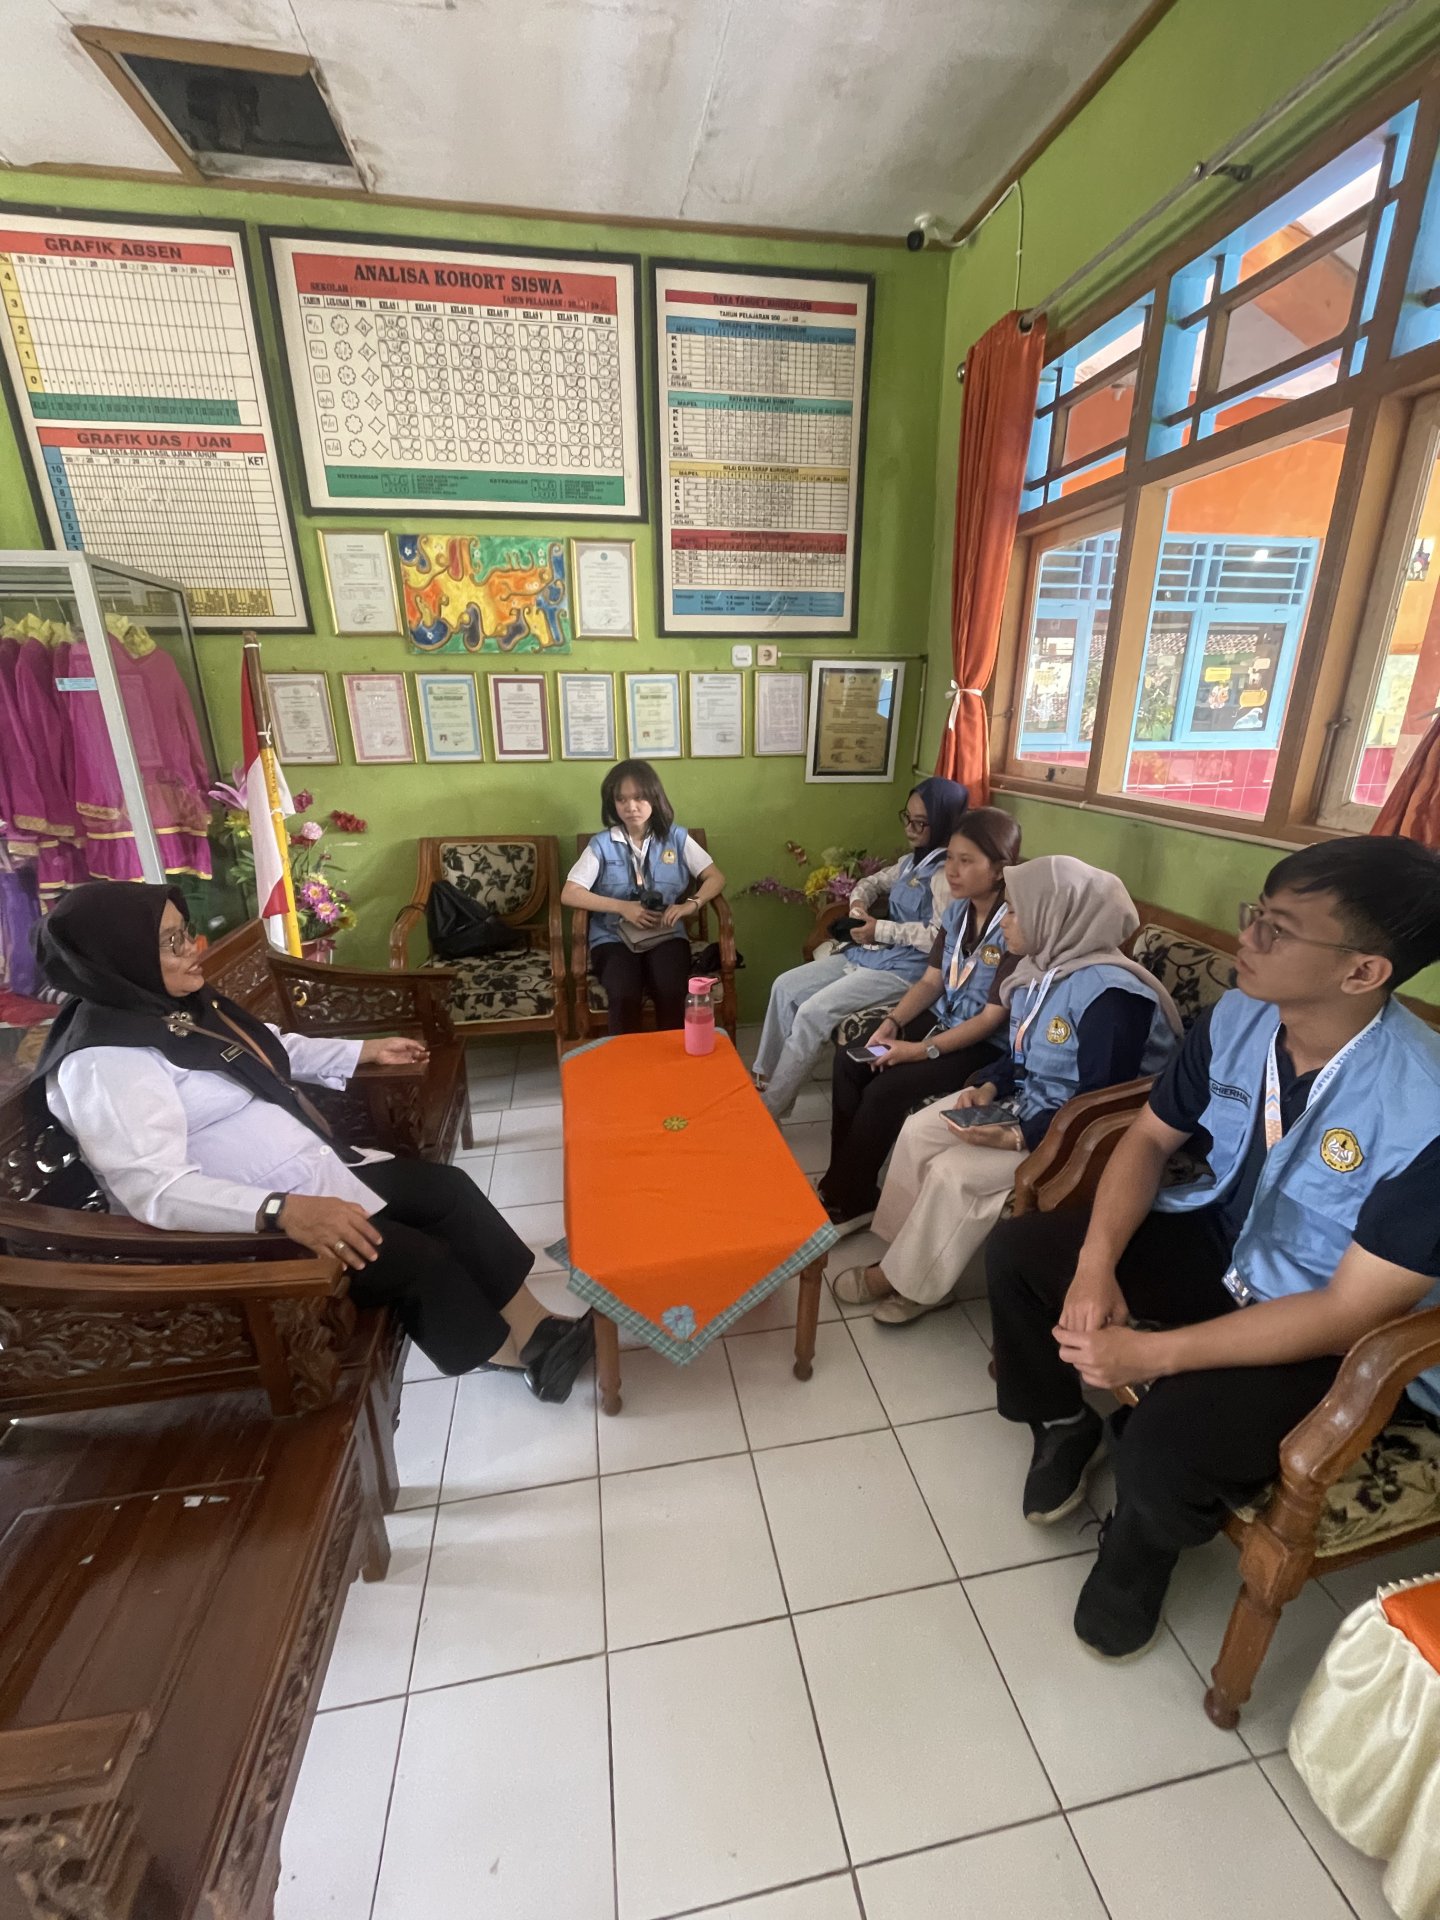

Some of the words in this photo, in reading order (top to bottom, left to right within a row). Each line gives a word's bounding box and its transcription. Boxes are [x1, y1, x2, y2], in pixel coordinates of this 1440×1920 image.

[44, 237, 114, 255] GRAFIK
[120, 243, 182, 260] ABSEN
[4, 272, 11, 281] 4
[218, 269, 231, 277] KET
[354, 264, 429, 285] ANALISA
[434, 270, 505, 290] KOHORT
[511, 276, 563, 294] SISWA
[310, 282, 349, 293] SEKOLAH
[11, 299, 18, 308] 3
[303, 296, 321, 305] TAHUN
[326, 297, 350, 307] LULUSAN
[379, 300, 395, 309] KELAS
[503, 295, 523, 304] TAHUN
[525, 297, 562, 307] PELAJARAN
[415, 303, 432, 312] KELAS
[451, 305, 466, 315] KELAS
[487, 308, 502, 317] KELAS
[523, 311, 538, 319] KELAS
[557, 313, 572, 321] KELAS
[18, 325, 25, 335] 2
[30, 375, 38, 385] 0
[77, 432, 142, 447] GRAFIK
[147, 435, 181, 449] UAS
[197, 437, 231, 450] UAN
[90, 448, 108, 457] NILAI
[150, 451, 170, 459] HASIL
[172, 452, 191, 460] UJIAN
[248, 457, 264, 466] KET
[51, 465, 62, 474] 10
[60, 489, 65, 497] 8
[62, 500, 67, 508] 7
[65, 511, 71, 519] 6
[68, 523, 73, 531] 5
[71, 534, 76, 542] 4
